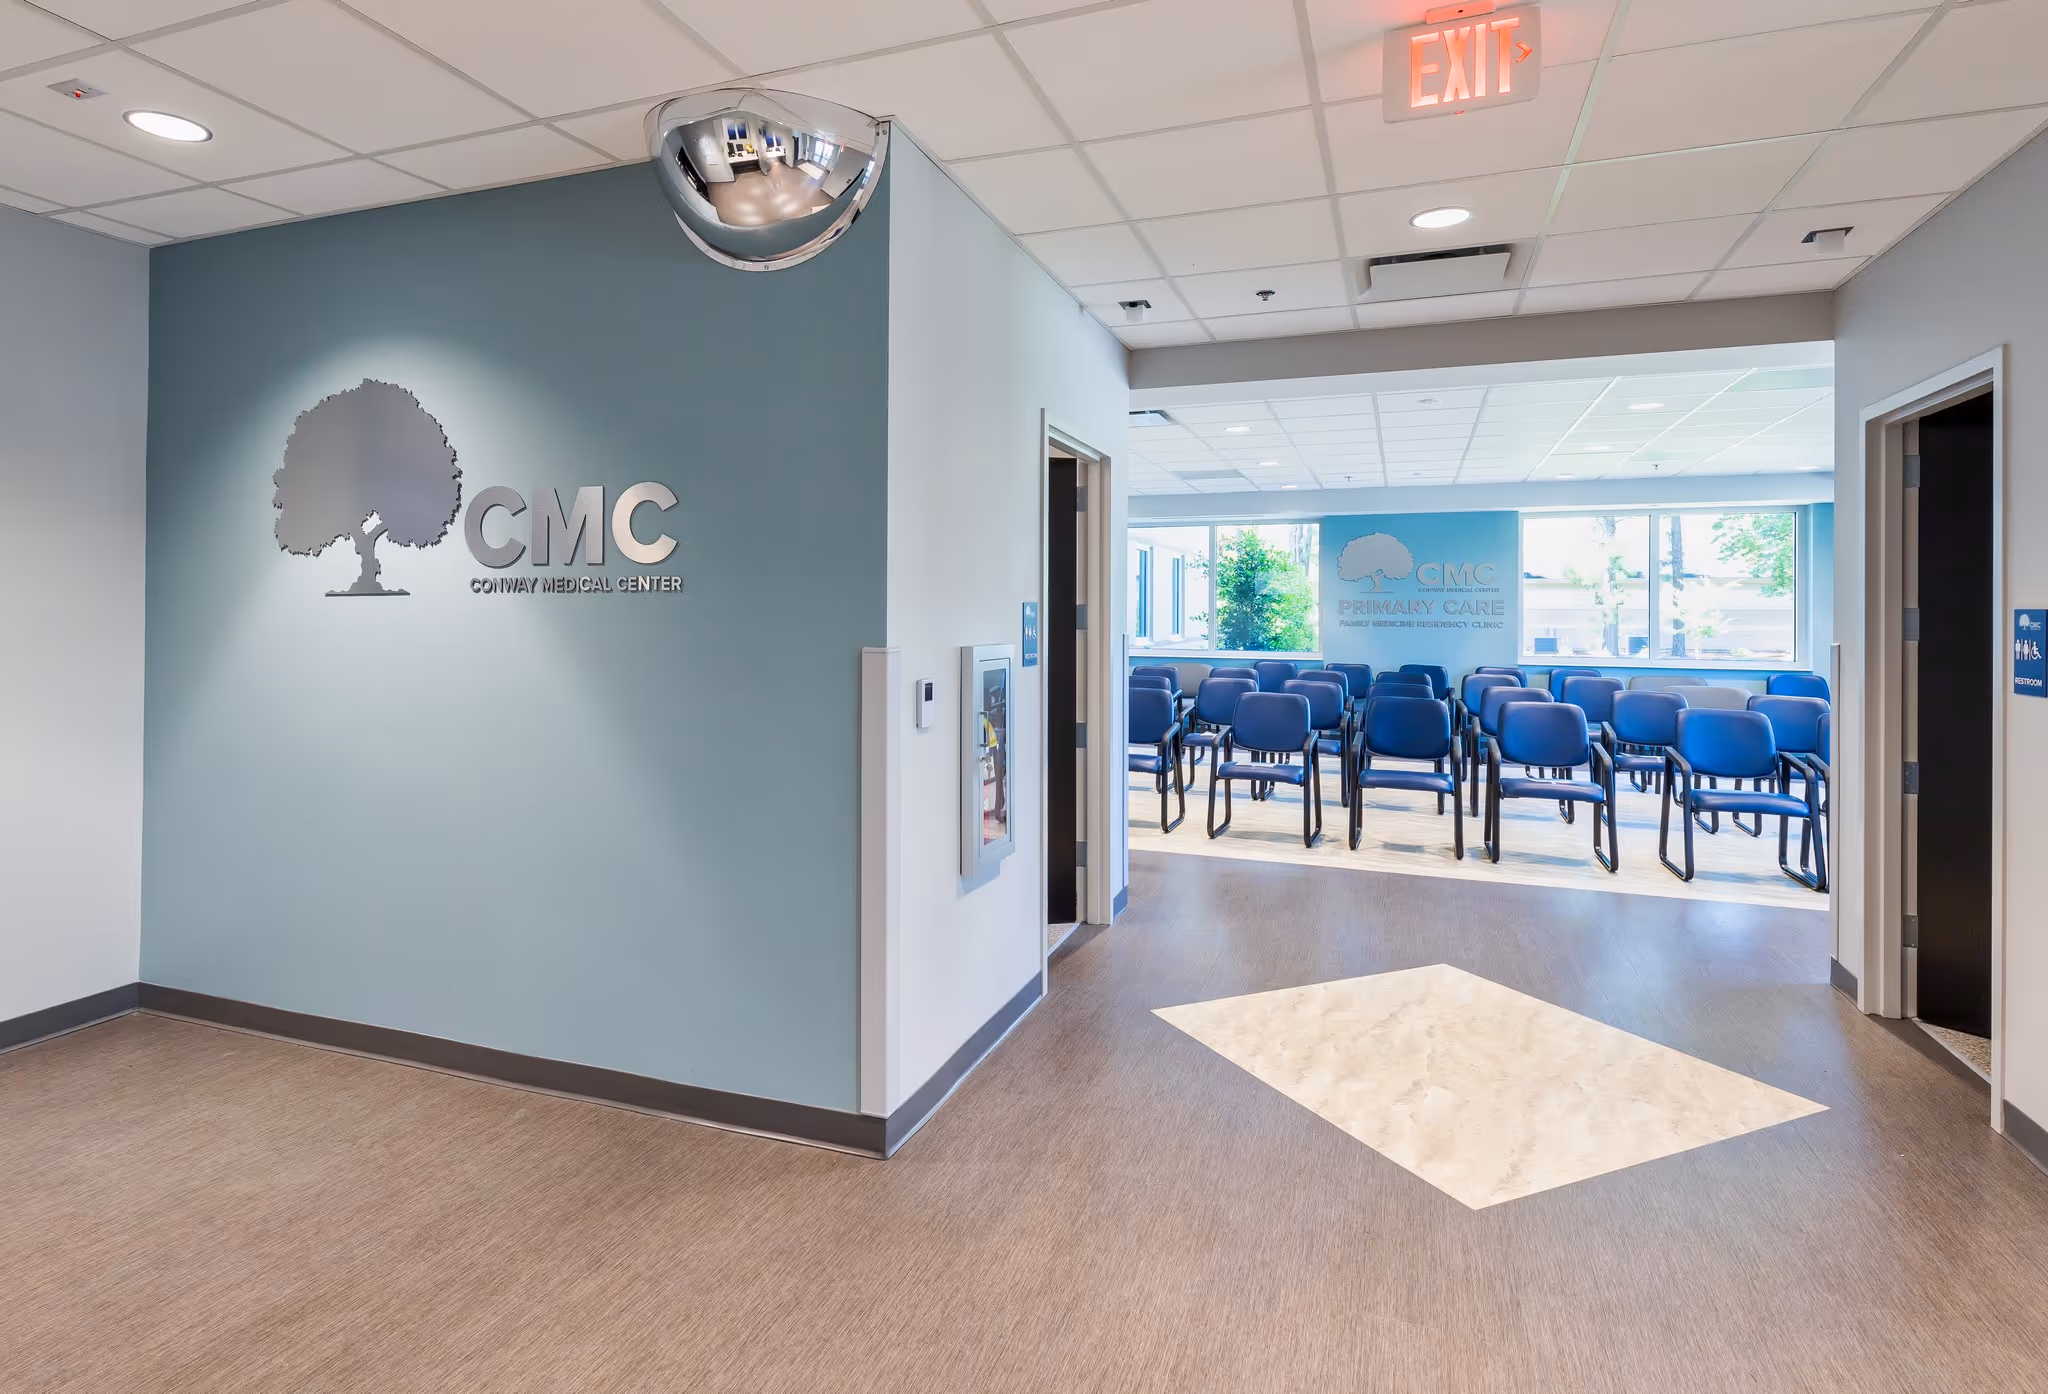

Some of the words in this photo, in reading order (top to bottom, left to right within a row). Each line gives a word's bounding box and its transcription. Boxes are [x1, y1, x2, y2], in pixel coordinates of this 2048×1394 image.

[1411, 17, 1520, 108] EXIT
[464, 481, 679, 569] CMC
[1416, 562, 1498, 586] CMC
[470, 577, 538, 594] CONWAY
[542, 577, 613, 594] MEDICAL
[616, 576, 684, 593] CENTER
[1338, 599, 1436, 615] PRIMARY
[1443, 599, 1505, 615] CARE
[1339, 620, 1370, 628] FAMILY
[1372, 620, 1415, 628] MEDICINE
[1471, 621, 1504, 629] CLINIC
[2015, 677, 2042, 687] RESTROOM
